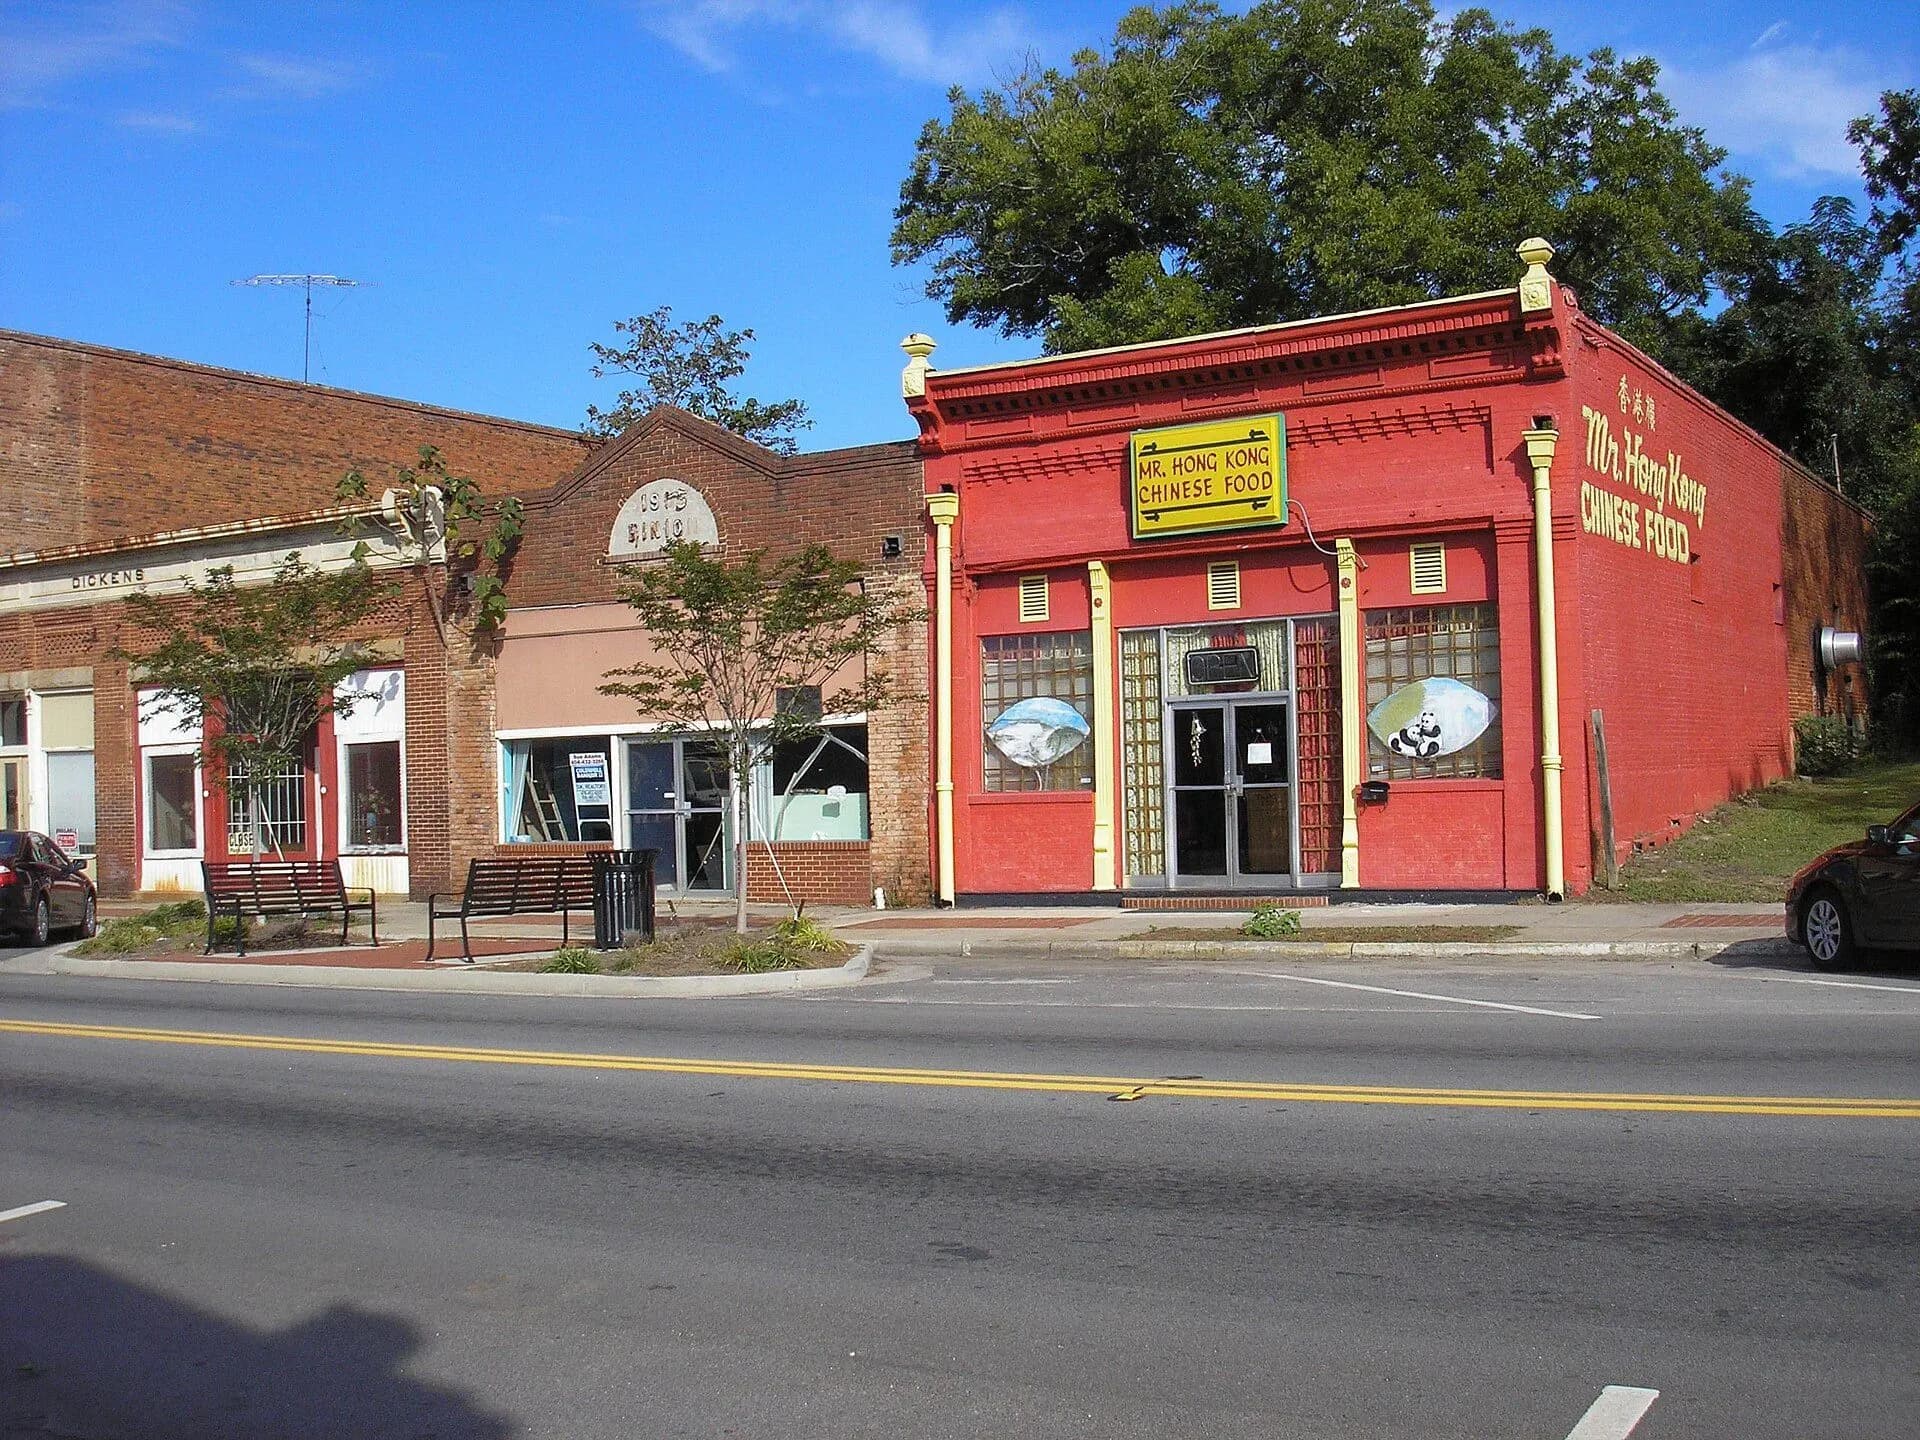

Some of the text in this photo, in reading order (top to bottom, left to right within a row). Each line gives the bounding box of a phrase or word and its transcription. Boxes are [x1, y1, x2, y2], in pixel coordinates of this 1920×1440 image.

[1139, 446, 1270, 481] MR. HONG KONG
[1582, 404, 1707, 531] Mr. Hong Kong
[1138, 471, 1273, 505] CHINESE FOOD
[1580, 480, 1690, 565] CHINESE FOOD
[72, 568, 145, 590] DICKENS
[1190, 653, 1256, 681] OPEN
[229, 832, 253, 847] CLOSE
